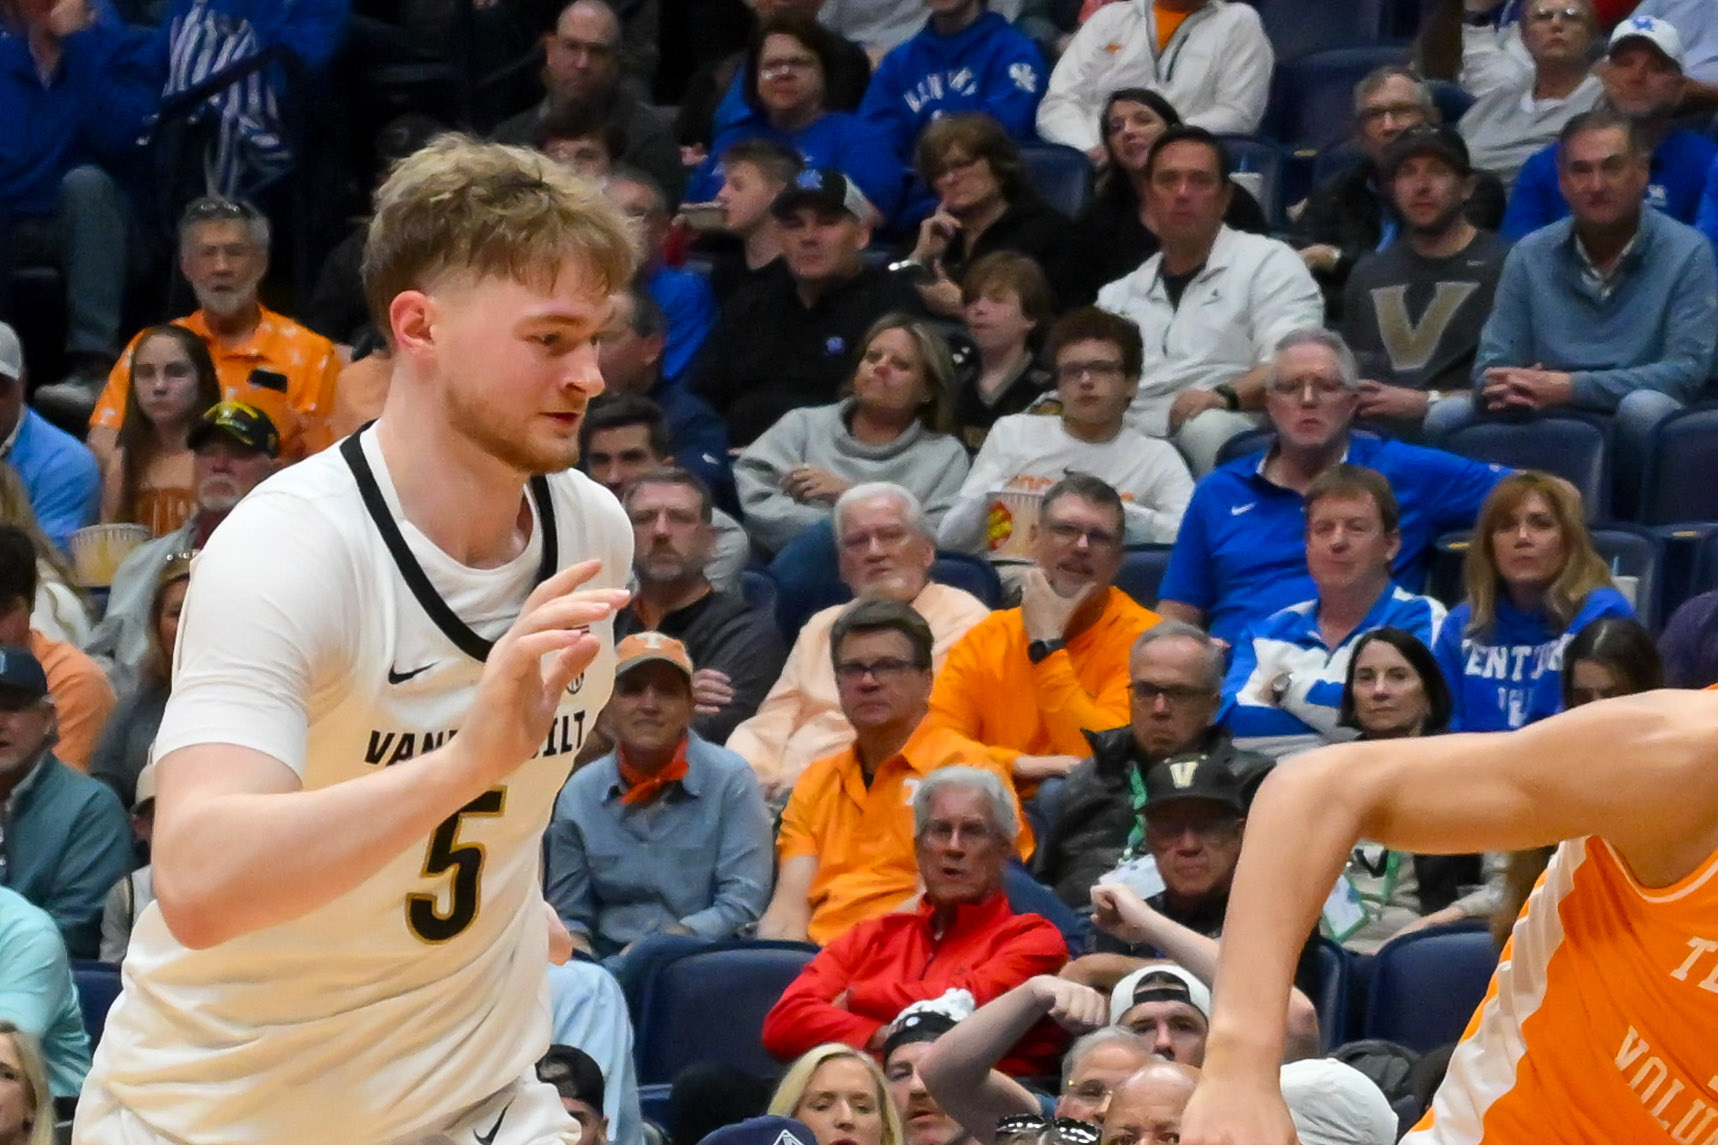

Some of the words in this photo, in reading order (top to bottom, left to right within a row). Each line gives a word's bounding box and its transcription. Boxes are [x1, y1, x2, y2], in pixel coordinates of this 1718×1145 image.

[1370, 281, 1479, 371] V
[635, 631, 669, 649] T
[365, 710, 586, 766] VANILT
[1169, 761, 1198, 789] V
[405, 786, 508, 945] 5
